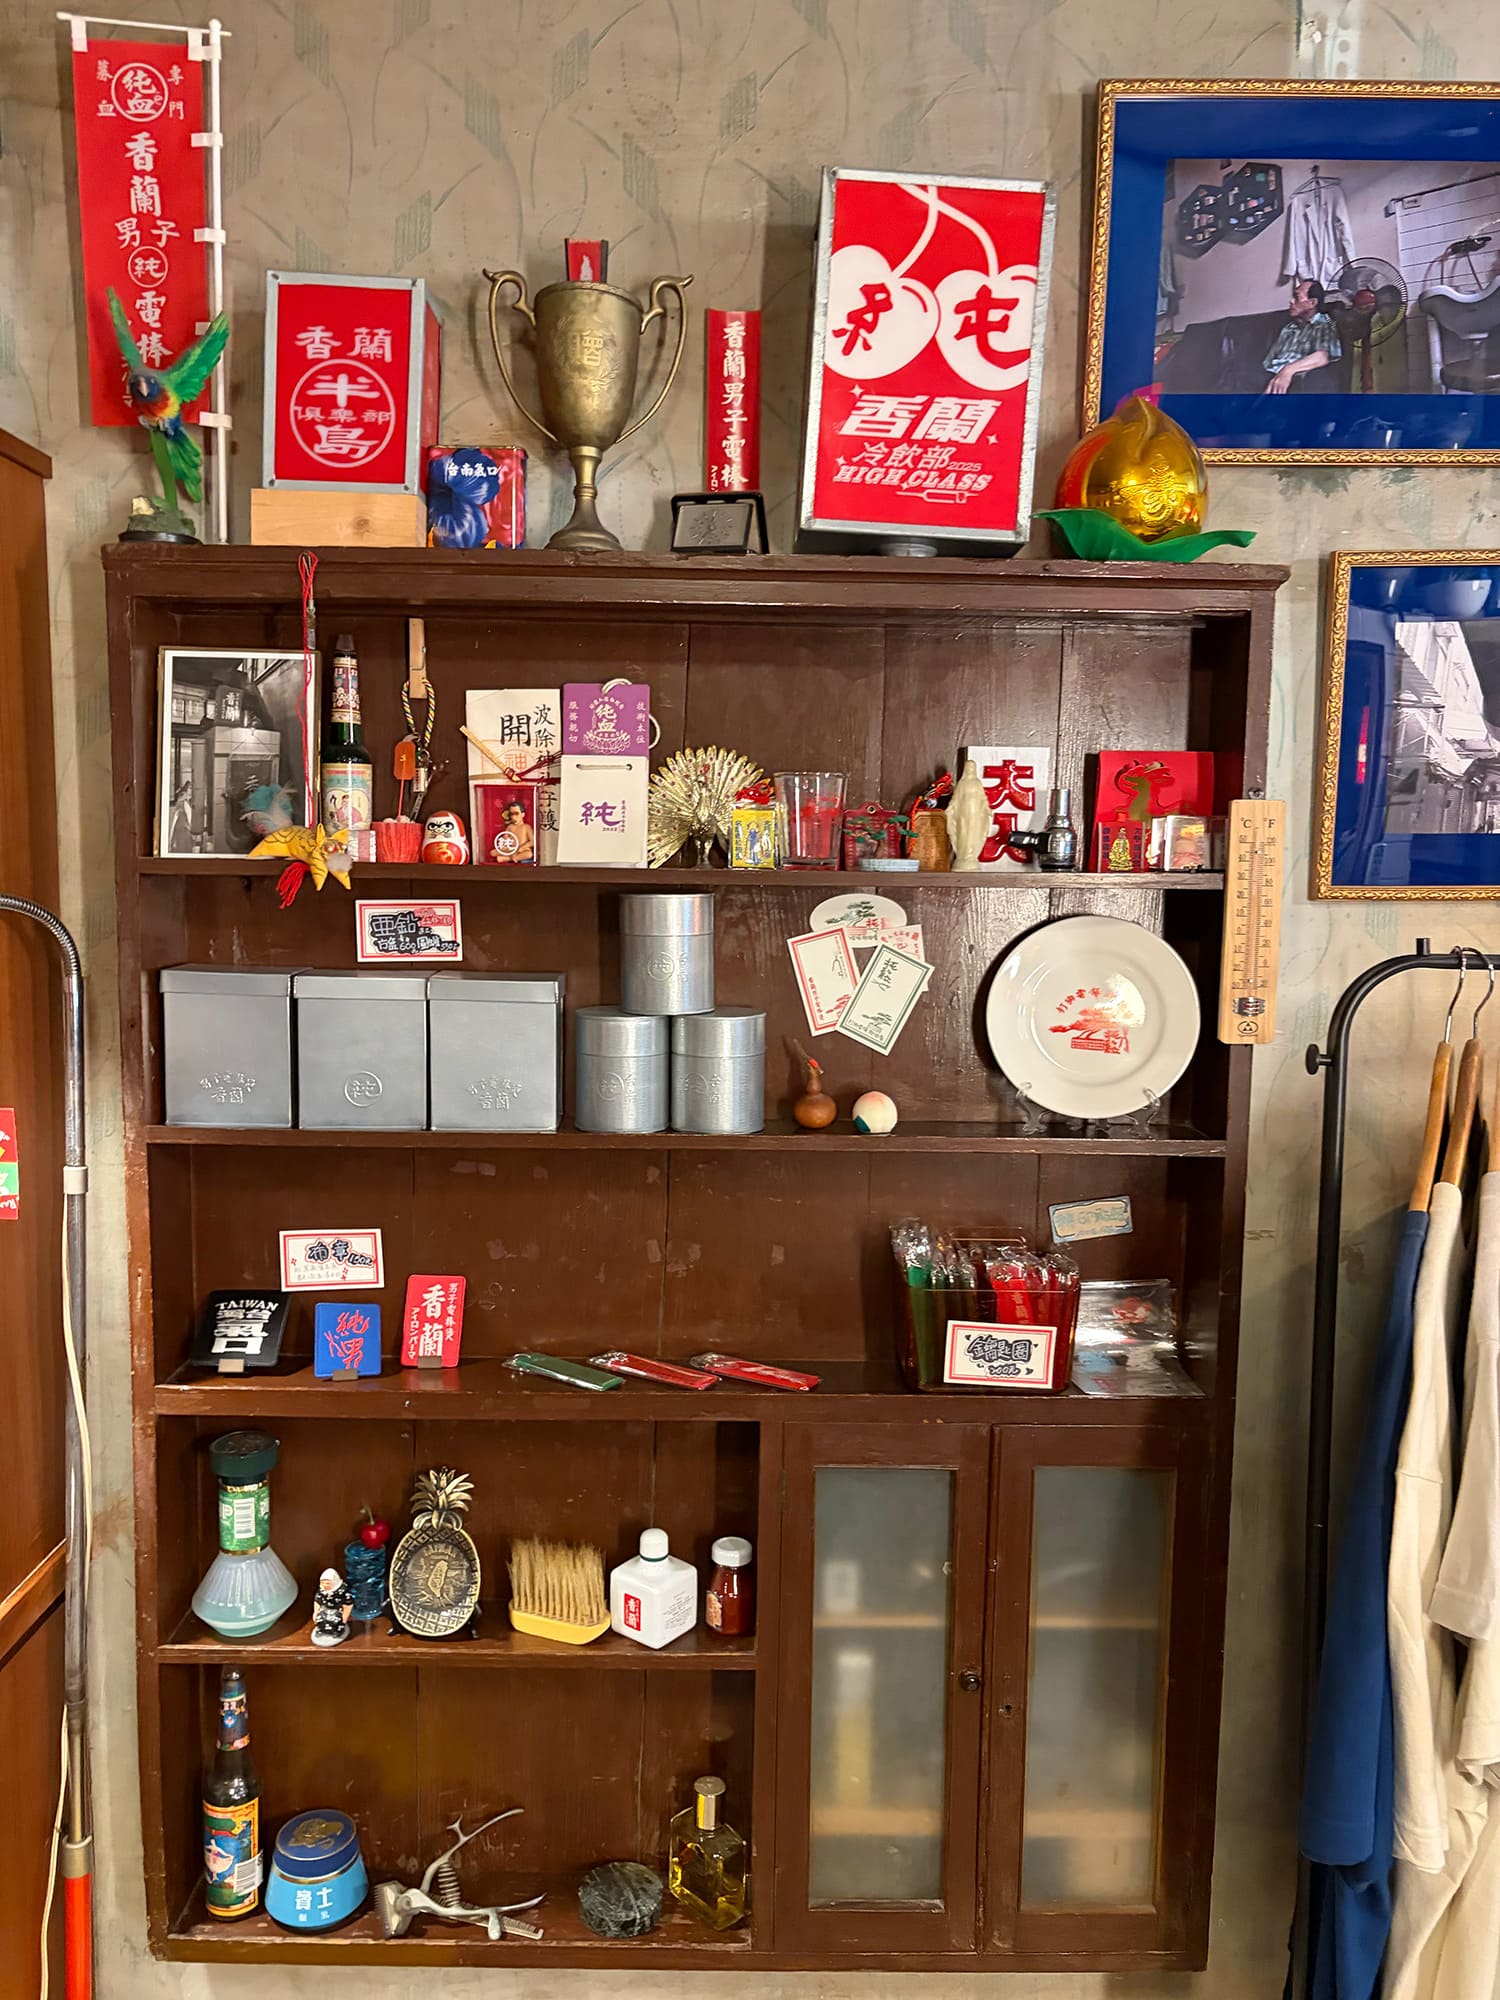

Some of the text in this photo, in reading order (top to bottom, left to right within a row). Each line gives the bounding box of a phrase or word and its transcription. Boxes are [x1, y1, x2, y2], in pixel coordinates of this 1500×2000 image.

[293, 325, 393, 364] 香蘭
[721, 320, 749, 489] 香蘭男子電棒
[838, 393, 1003, 445] 香蘭
[446, 461, 500, 478] 台南氣口
[851, 440, 958, 472] 冷飲部
[832, 464, 994, 492] HIGH CLASS
[500, 713, 533, 747] 開
[579, 801, 621, 827] 純
[309, 1241, 349, 1262] 布章
[214, 1299, 279, 1312] TAIWAN
[421, 1283, 446, 1357] 香蘭
